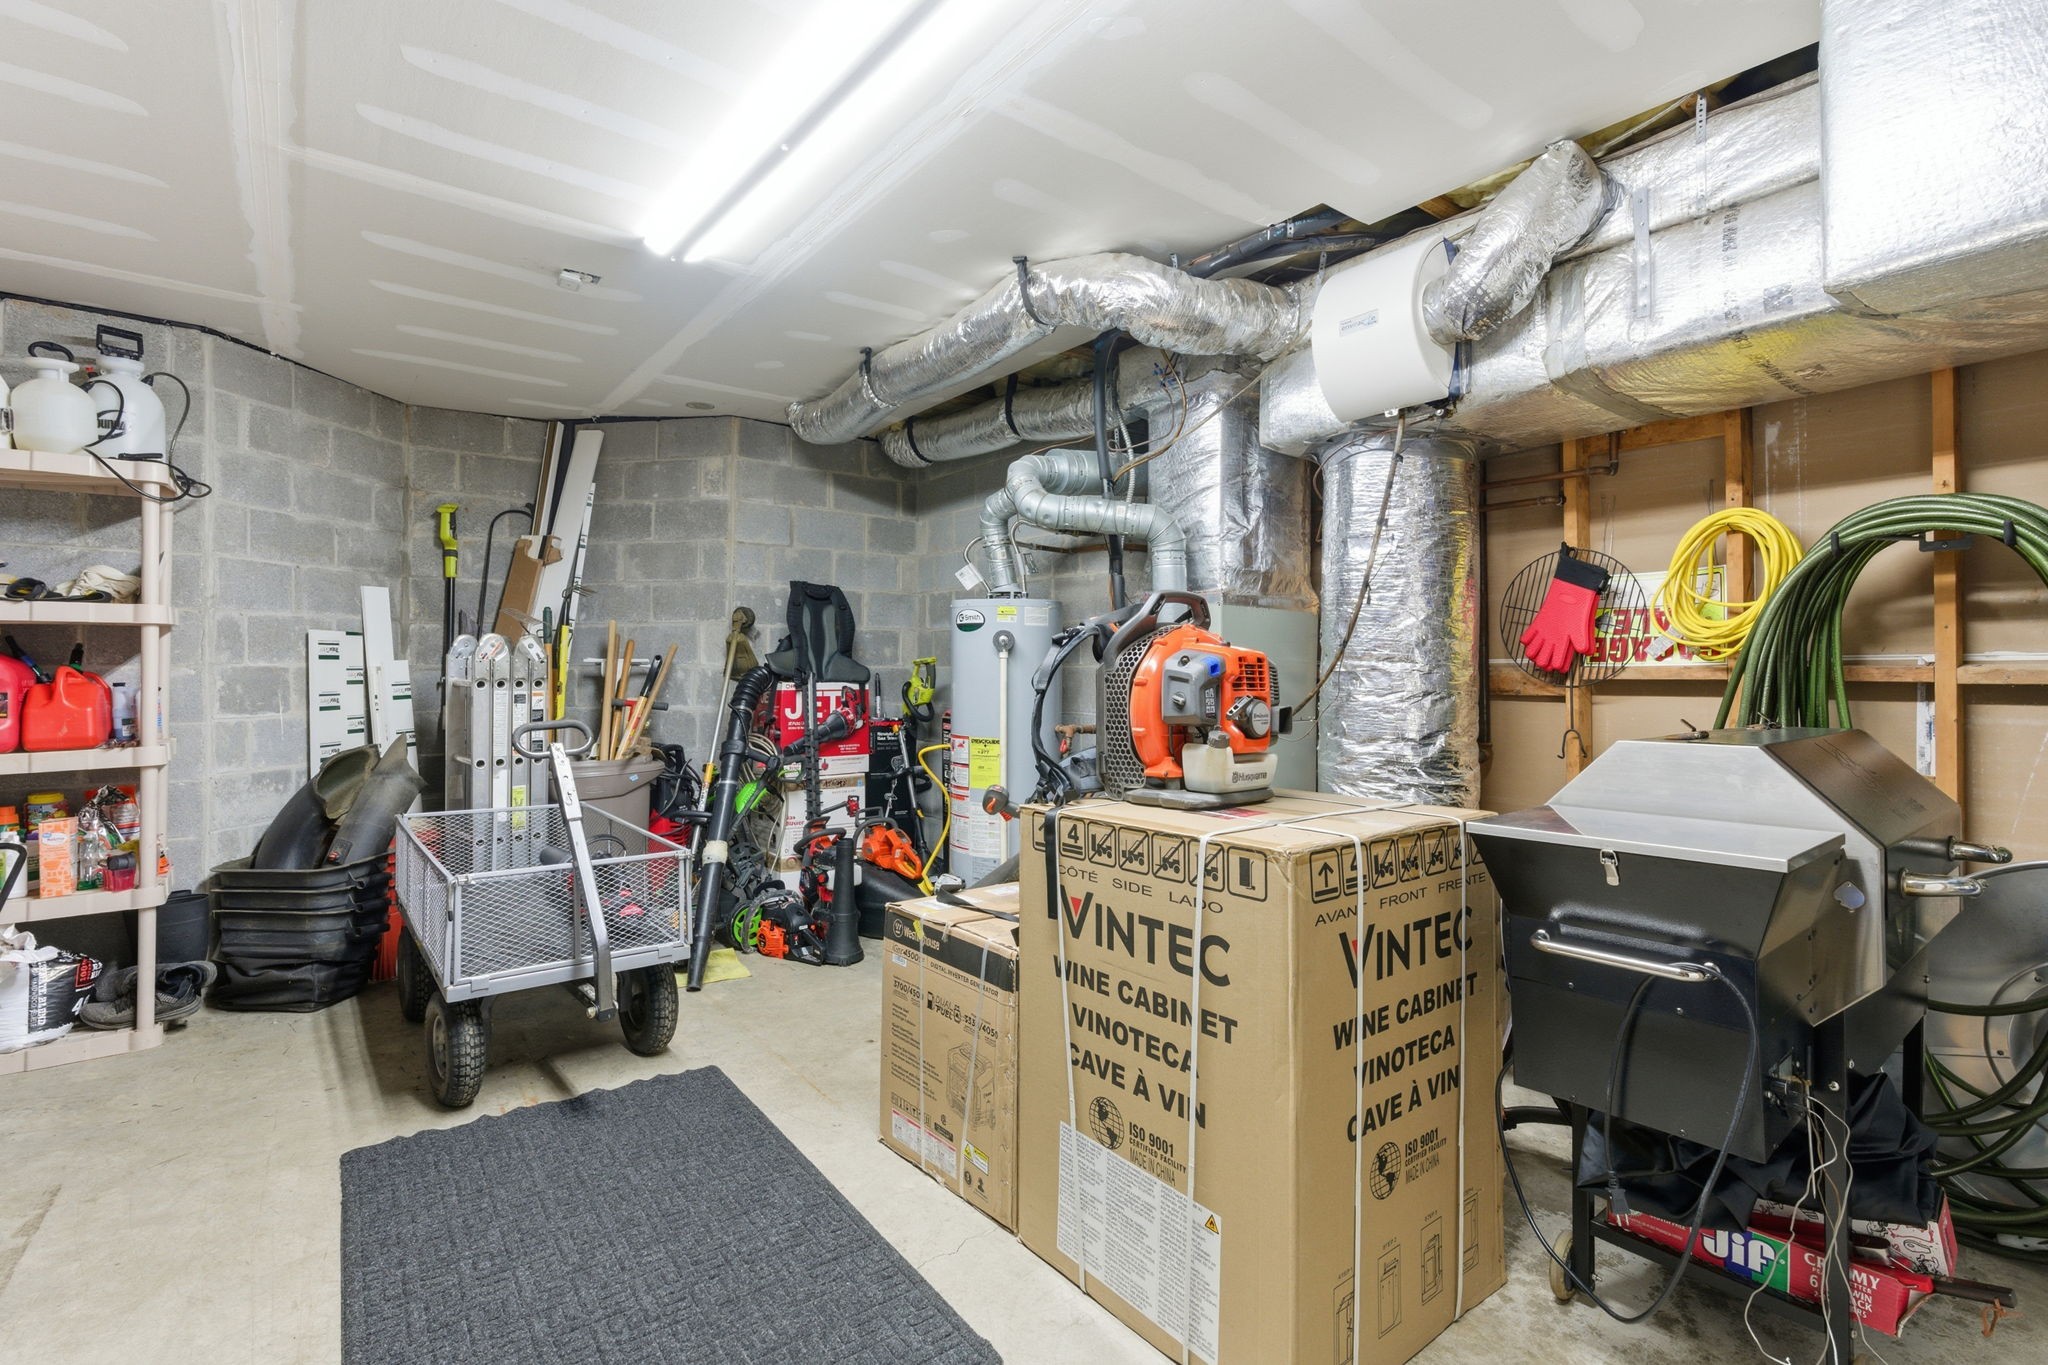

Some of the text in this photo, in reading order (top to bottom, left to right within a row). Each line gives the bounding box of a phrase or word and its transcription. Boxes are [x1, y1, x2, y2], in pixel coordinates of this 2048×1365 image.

[1058, 864, 1098, 883] CÔTÉ
[1112, 878, 1152, 897] SIDE
[1315, 903, 1367, 927] AVAN
[1380, 887, 1427, 909] FRONT
[1058, 884, 1231, 988] VINTEC
[1339, 905, 1473, 989] VINTEC
[1053, 955, 1238, 1044] WINE CABINET
[1071, 1002, 1200, 1079] VINOTECA
[1070, 1042, 1206, 1129] CAVE À VIN
[1347, 1064, 1460, 1142] CAVE À VIN
[1129, 1122, 1174, 1157] ISO 9001
[1129, 1138, 1187, 1174] CERTIFIED FACILITY
[1405, 1127, 1439, 1158] ISO 9001
[1703, 1230, 1775, 1272] Jif
[1810, 1274, 1819, 1288] 6
